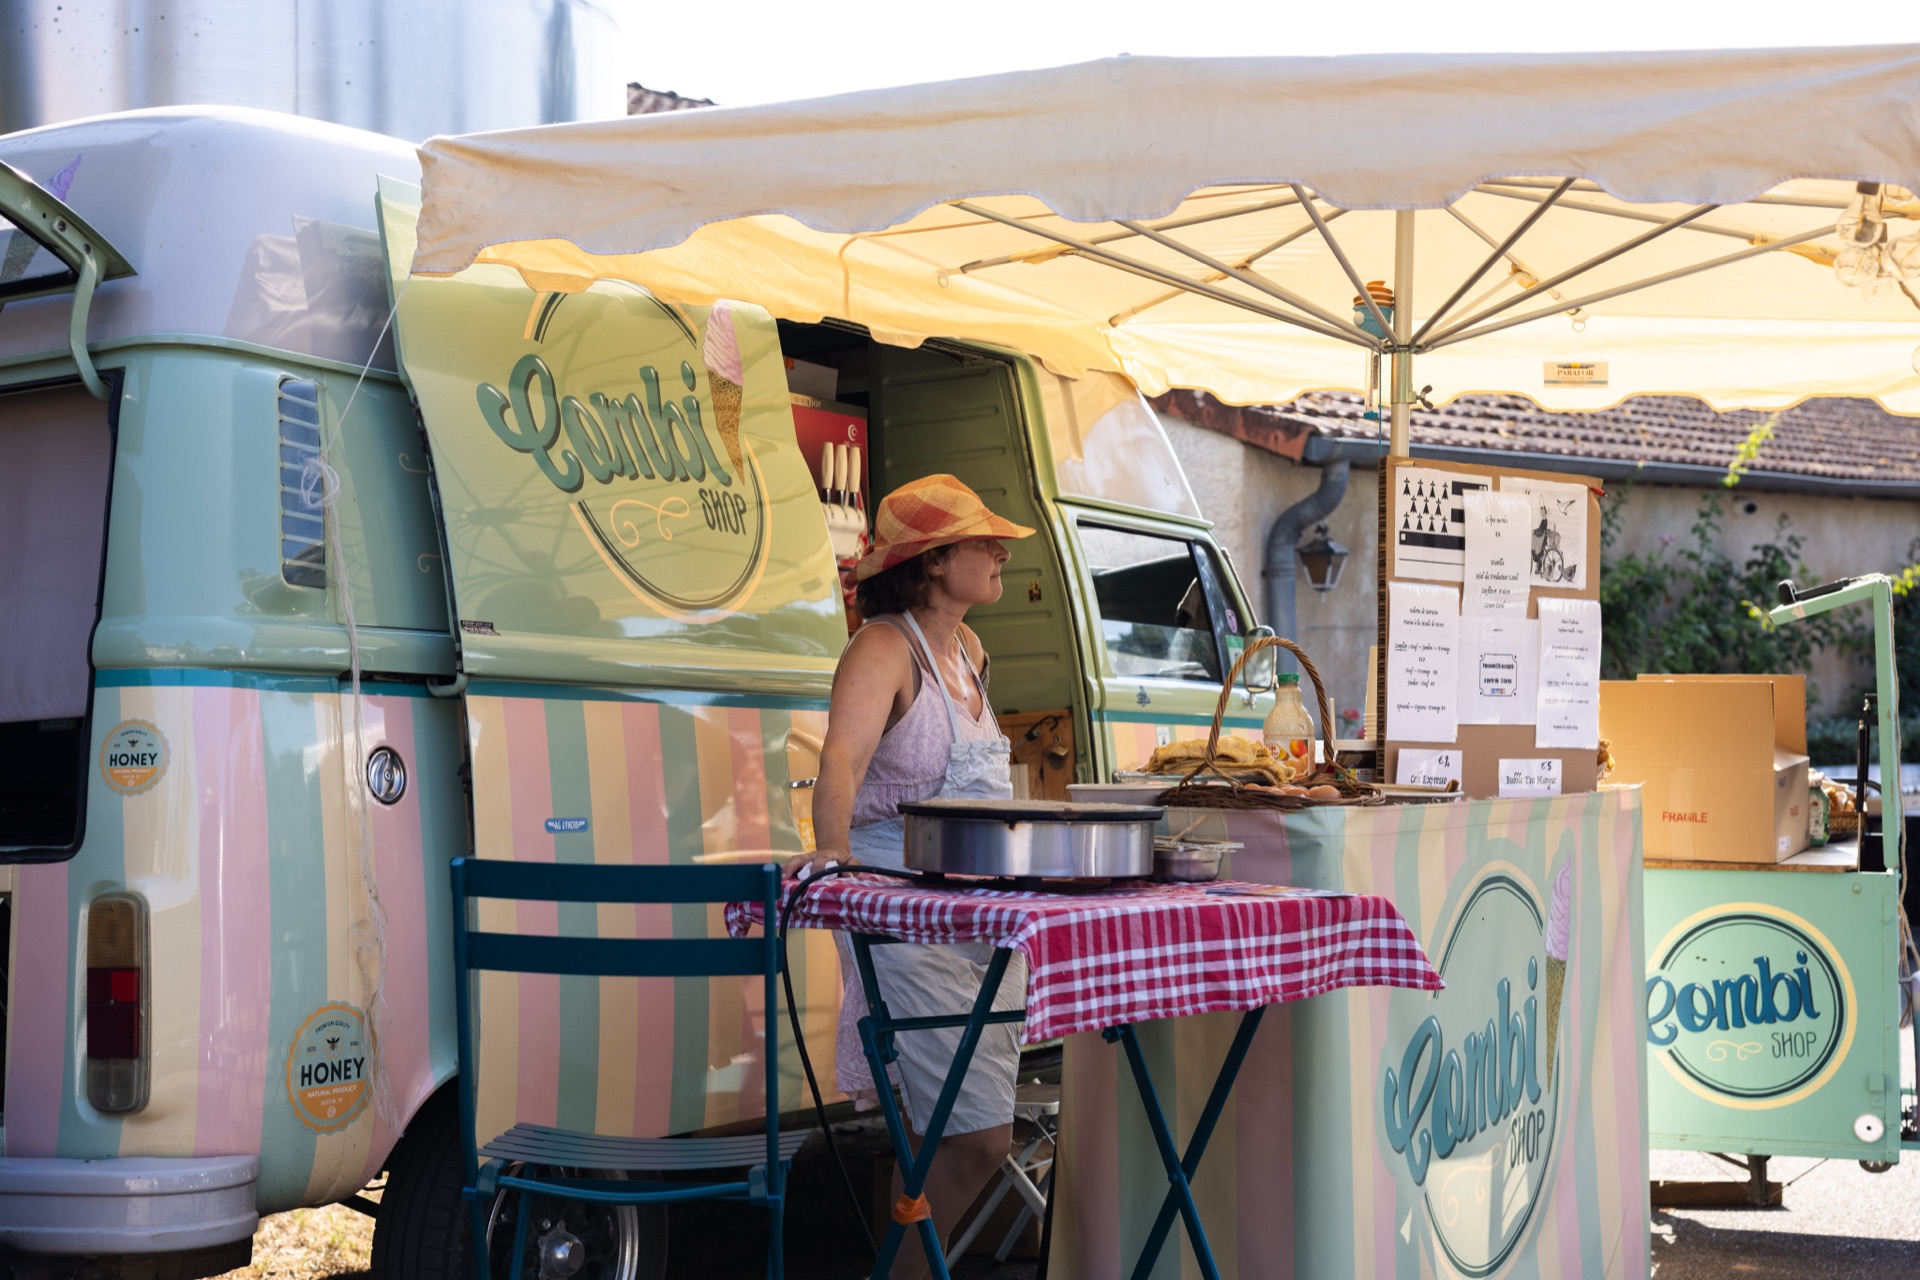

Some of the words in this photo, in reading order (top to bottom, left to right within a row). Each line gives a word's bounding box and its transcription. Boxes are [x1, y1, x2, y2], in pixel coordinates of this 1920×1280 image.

[476, 354, 733, 493] Combi
[698, 488, 747, 536] SHOP
[109, 752, 159, 767] HONEY
[1662, 811, 1708, 823] FRAGILE
[1771, 1031, 1818, 1058] SHOP
[301, 1056, 366, 1087] HONEY
[1384, 955, 1542, 1187] Combi
[307, 1089, 332, 1098] NATURAL
[332, 1085, 358, 1095] PRODUCT
[1510, 1109, 1545, 1168] SHOP
